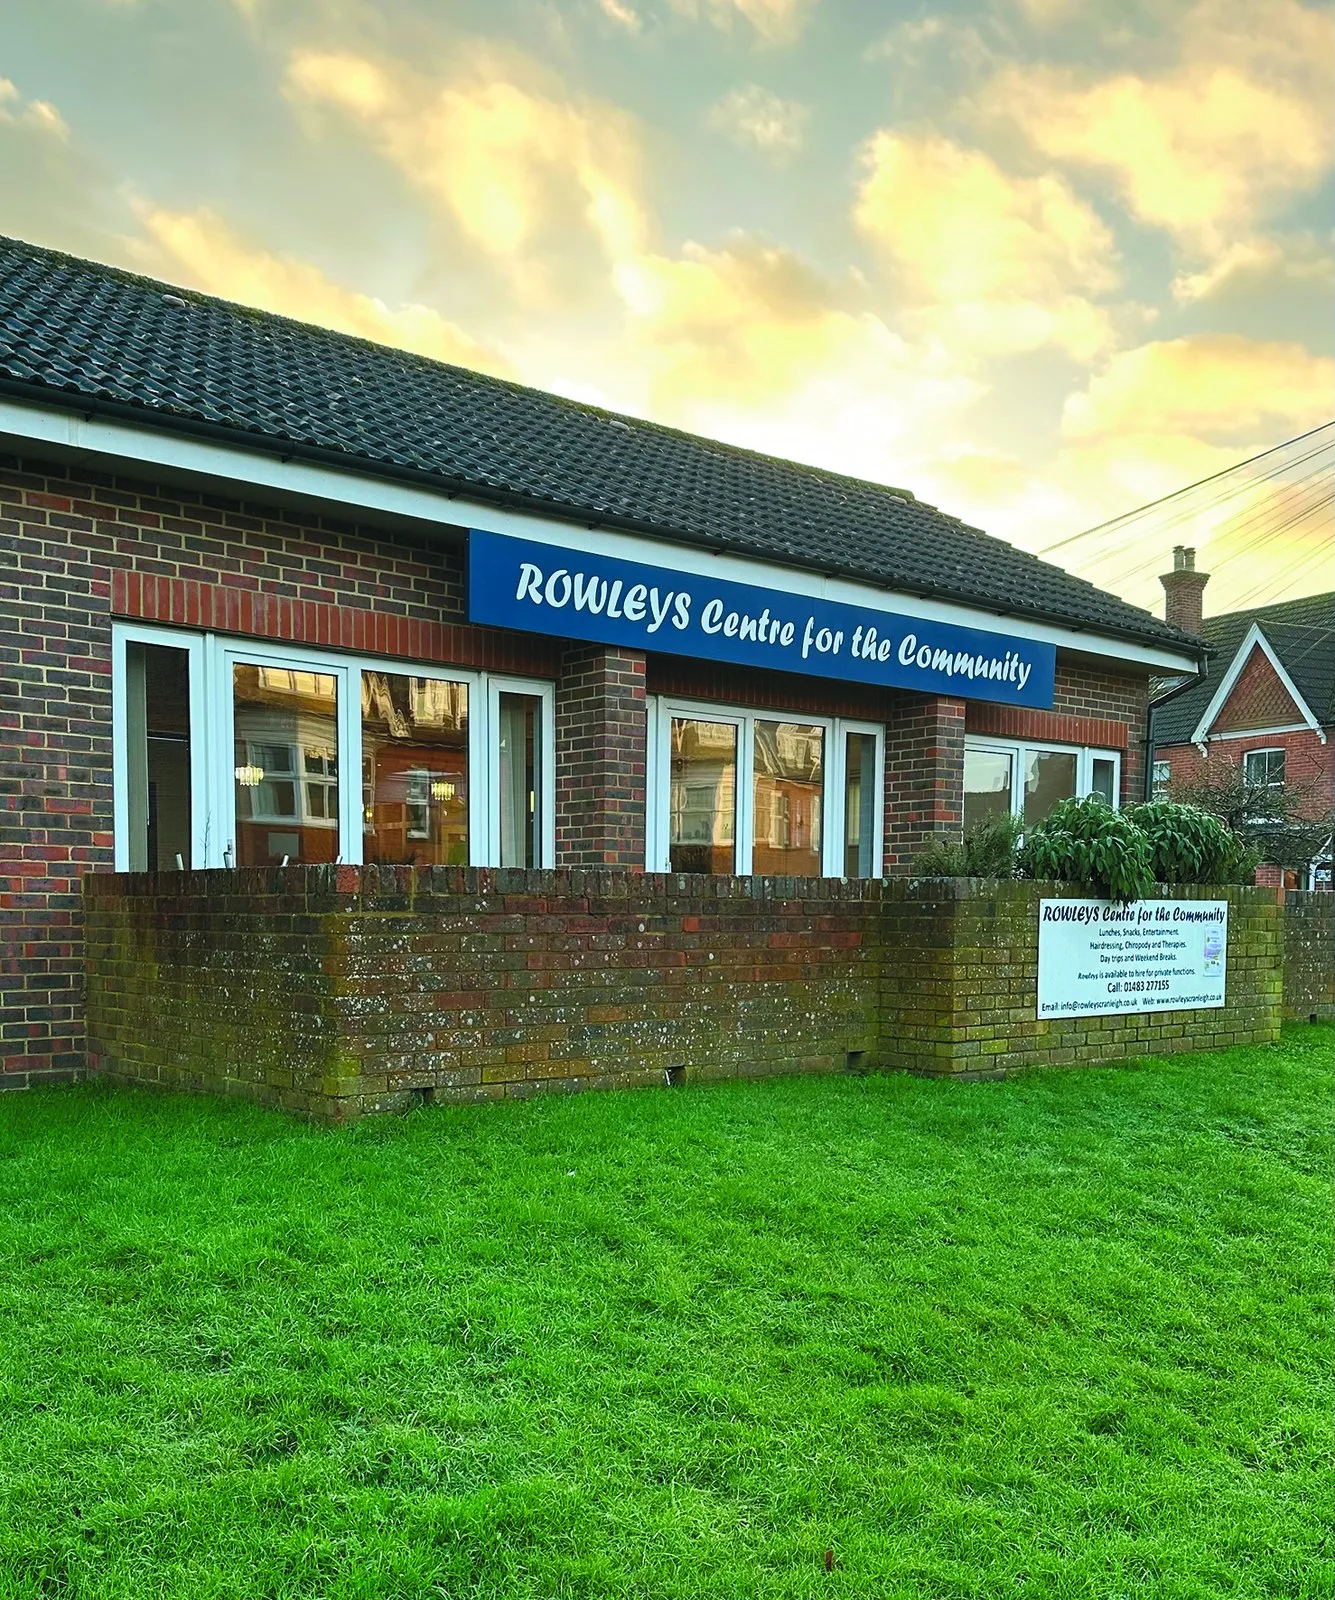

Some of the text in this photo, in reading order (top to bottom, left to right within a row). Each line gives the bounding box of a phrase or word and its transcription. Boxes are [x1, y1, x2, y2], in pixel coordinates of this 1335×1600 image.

[516, 563, 1032, 691] ROWLEYS Centre for the Community
[1043, 906, 1225, 925] ROWLEYS Centre for the Community
[1099, 928, 1179, 937] Lunches, Snacks, Entertainment.
[1090, 940, 1187, 951] Hairdressing, Chiropody and Therapies.
[1100, 953, 1177, 964] Day trips and Weekend Breaks.
[1078, 967, 1196, 980] Rowleys is available to hire for private functions.
[1107, 980, 1170, 993] Call: 01483 277155
[1041, 993, 1222, 1012] Email: info@rowleyscranleigh.co.uk Web: www.rowleyscranleigh.co.uk
